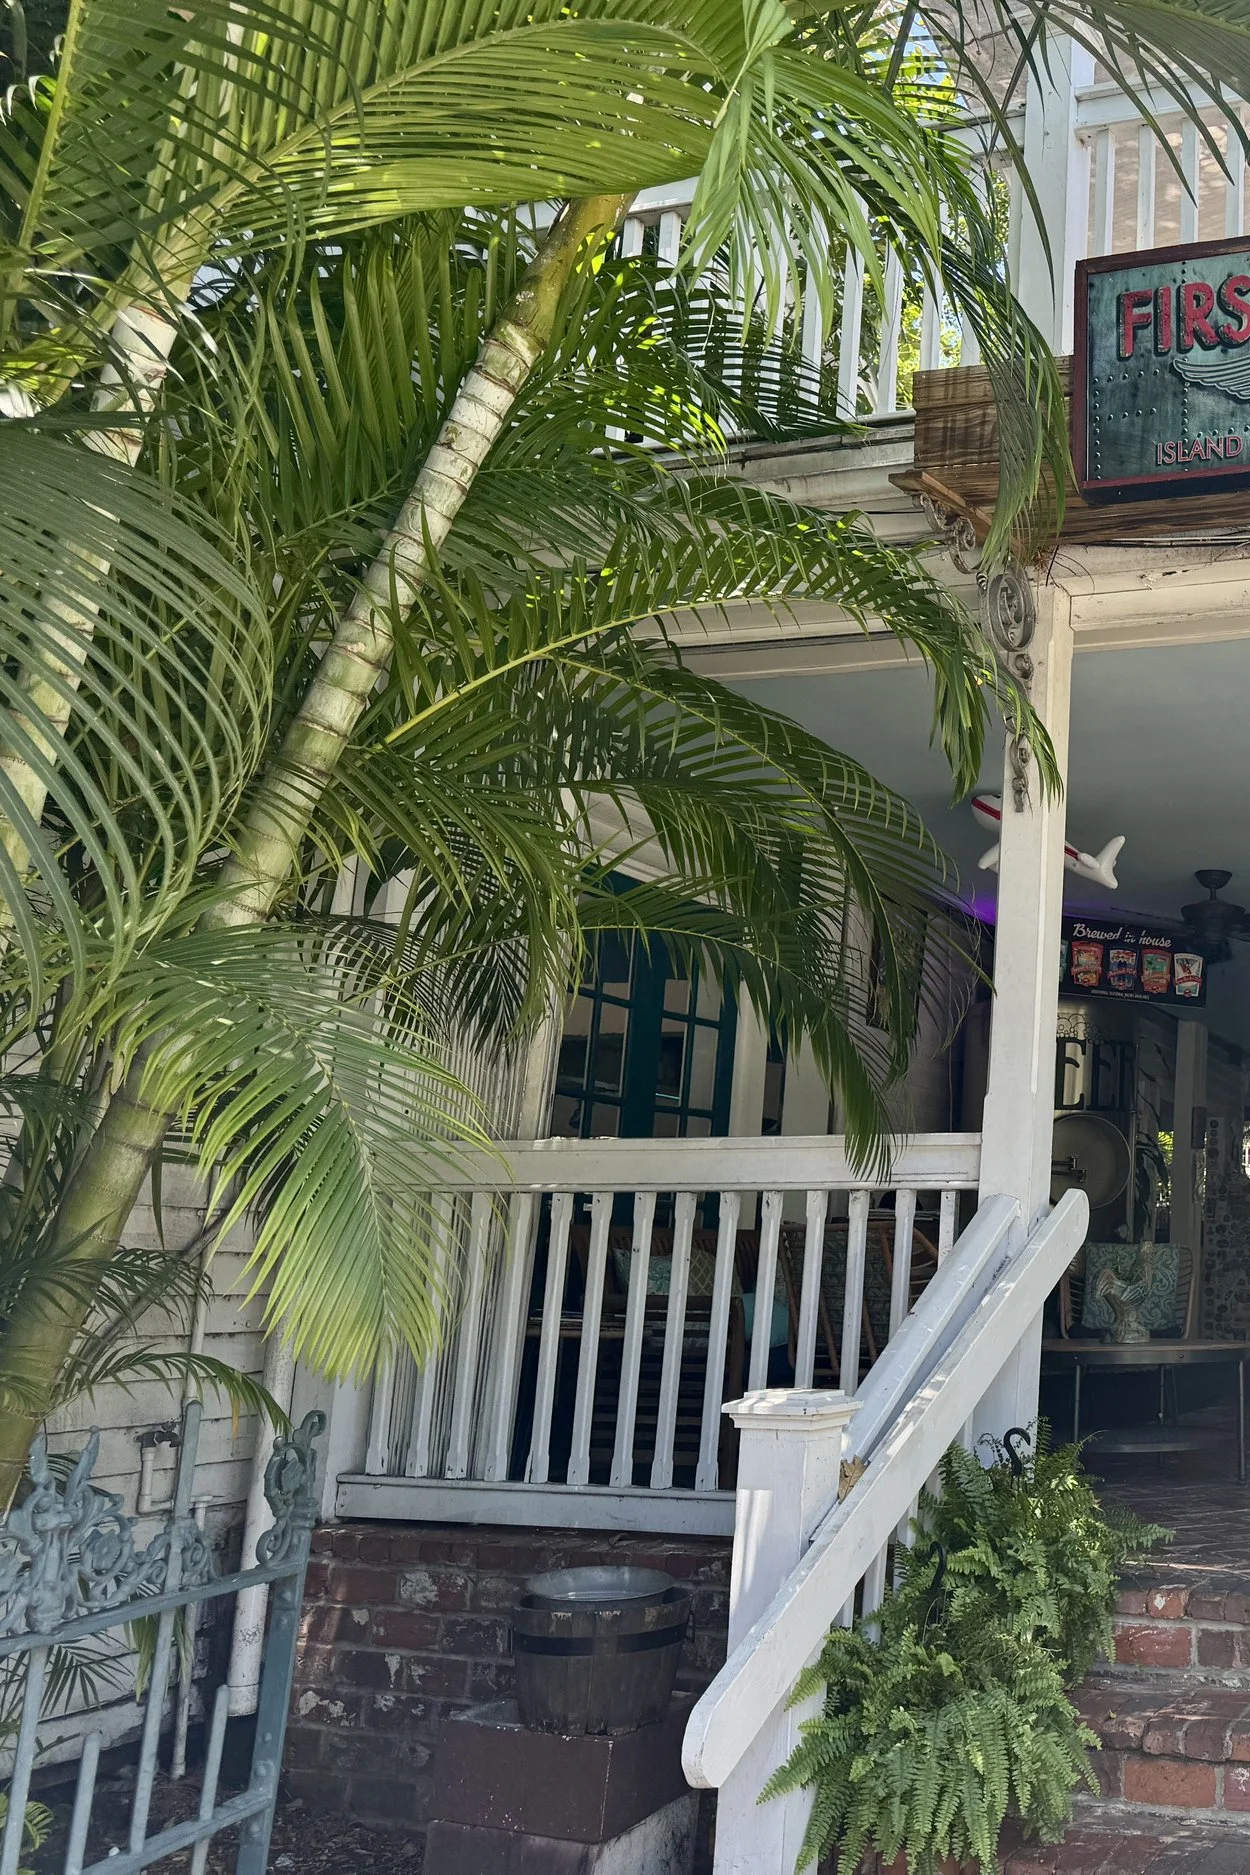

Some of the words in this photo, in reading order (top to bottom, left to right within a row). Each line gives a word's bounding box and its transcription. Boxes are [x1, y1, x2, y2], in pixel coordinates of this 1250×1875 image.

[1156, 434, 1243, 465] ISLAND
[1072, 923, 1123, 940] Brewed
[1138, 930, 1172, 948] house
[1054, 1037, 1136, 1111] EER
